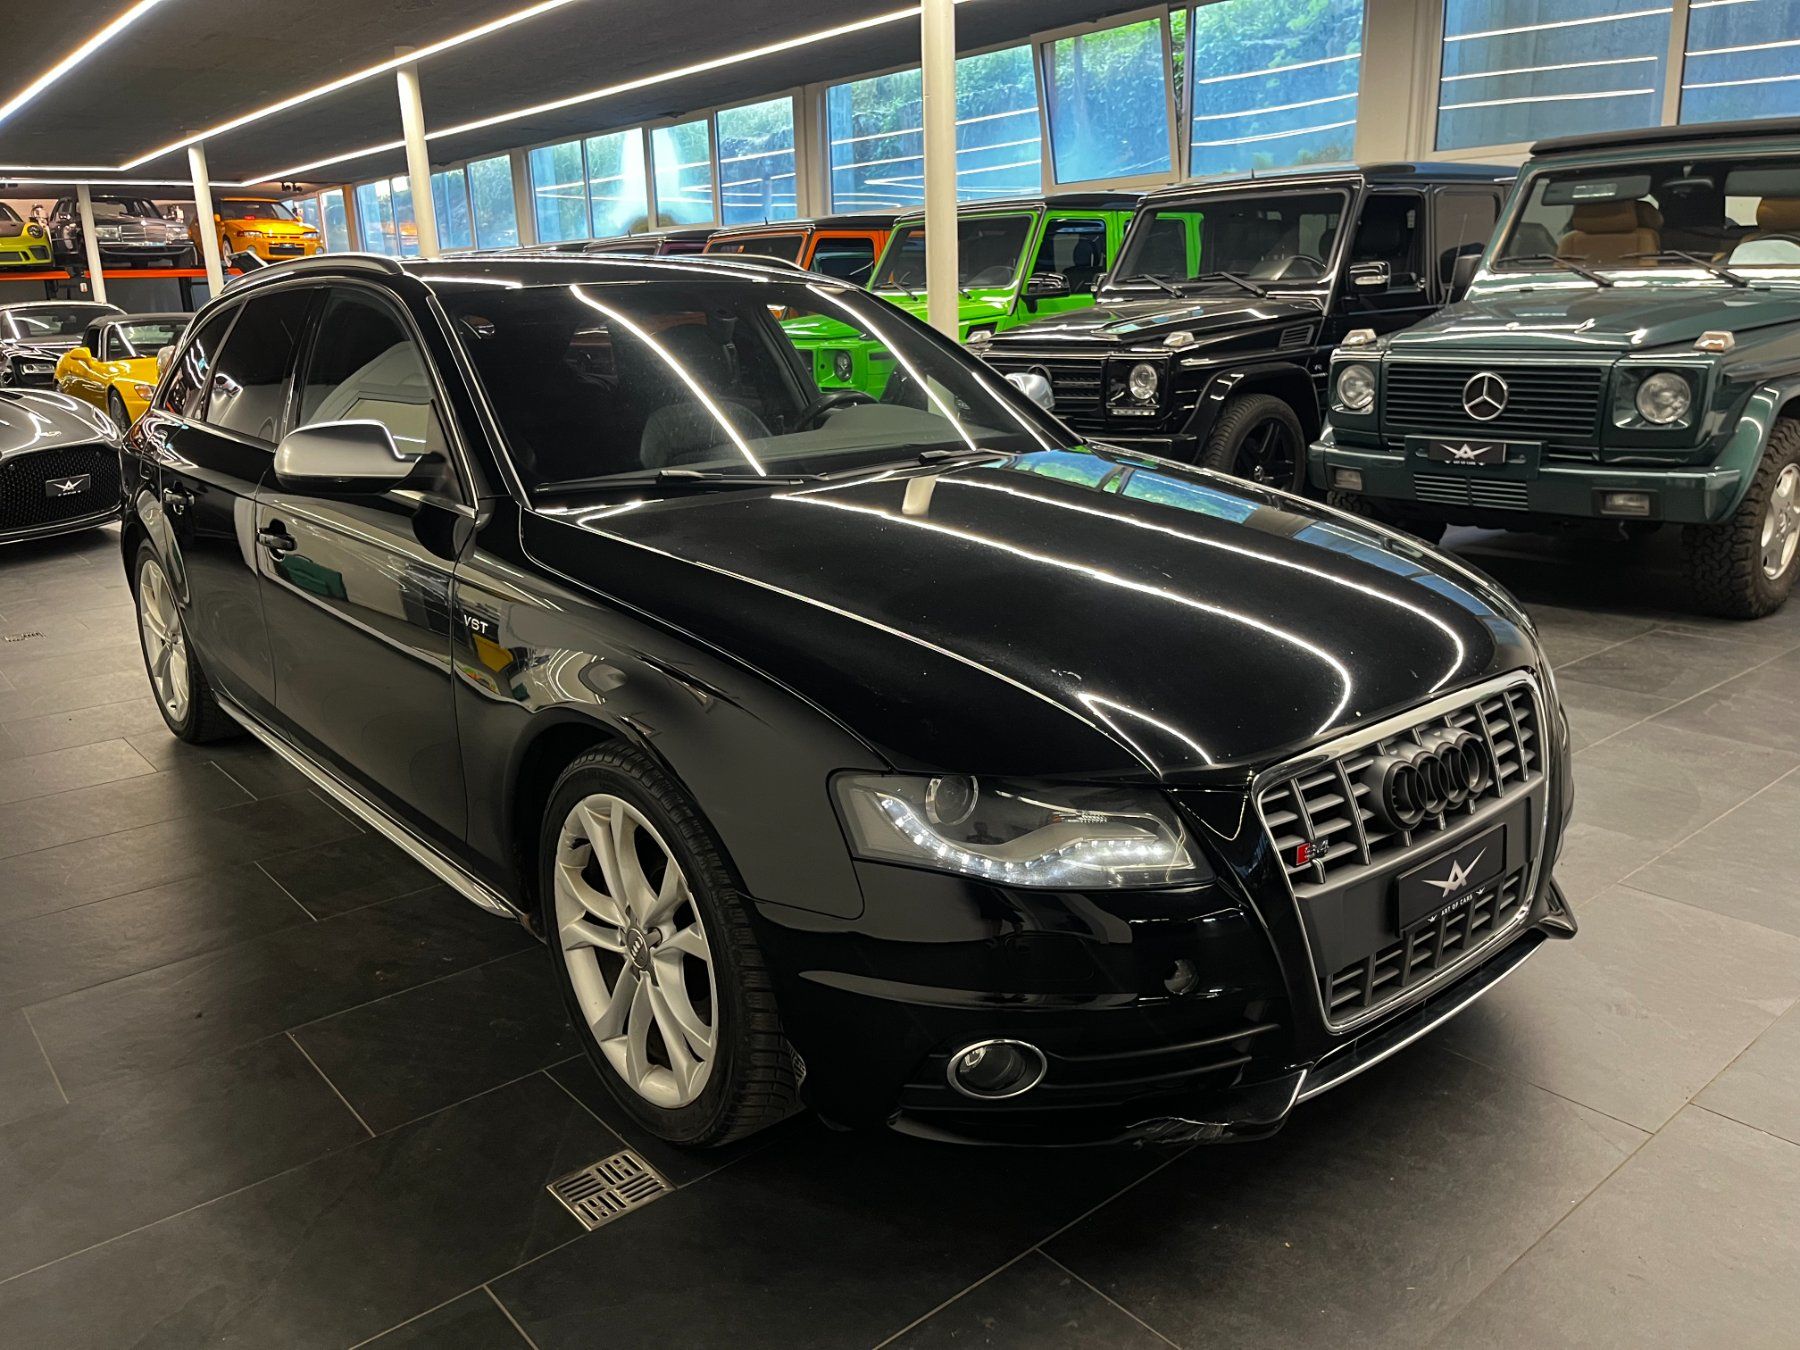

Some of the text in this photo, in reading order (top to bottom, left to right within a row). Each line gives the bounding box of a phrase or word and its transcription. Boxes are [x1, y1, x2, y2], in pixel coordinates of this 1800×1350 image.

[463, 614, 489, 634] V6T
[1303, 840, 1330, 859] S4
[1441, 905, 1451, 916] ART
[1451, 901, 1459, 910] OF
